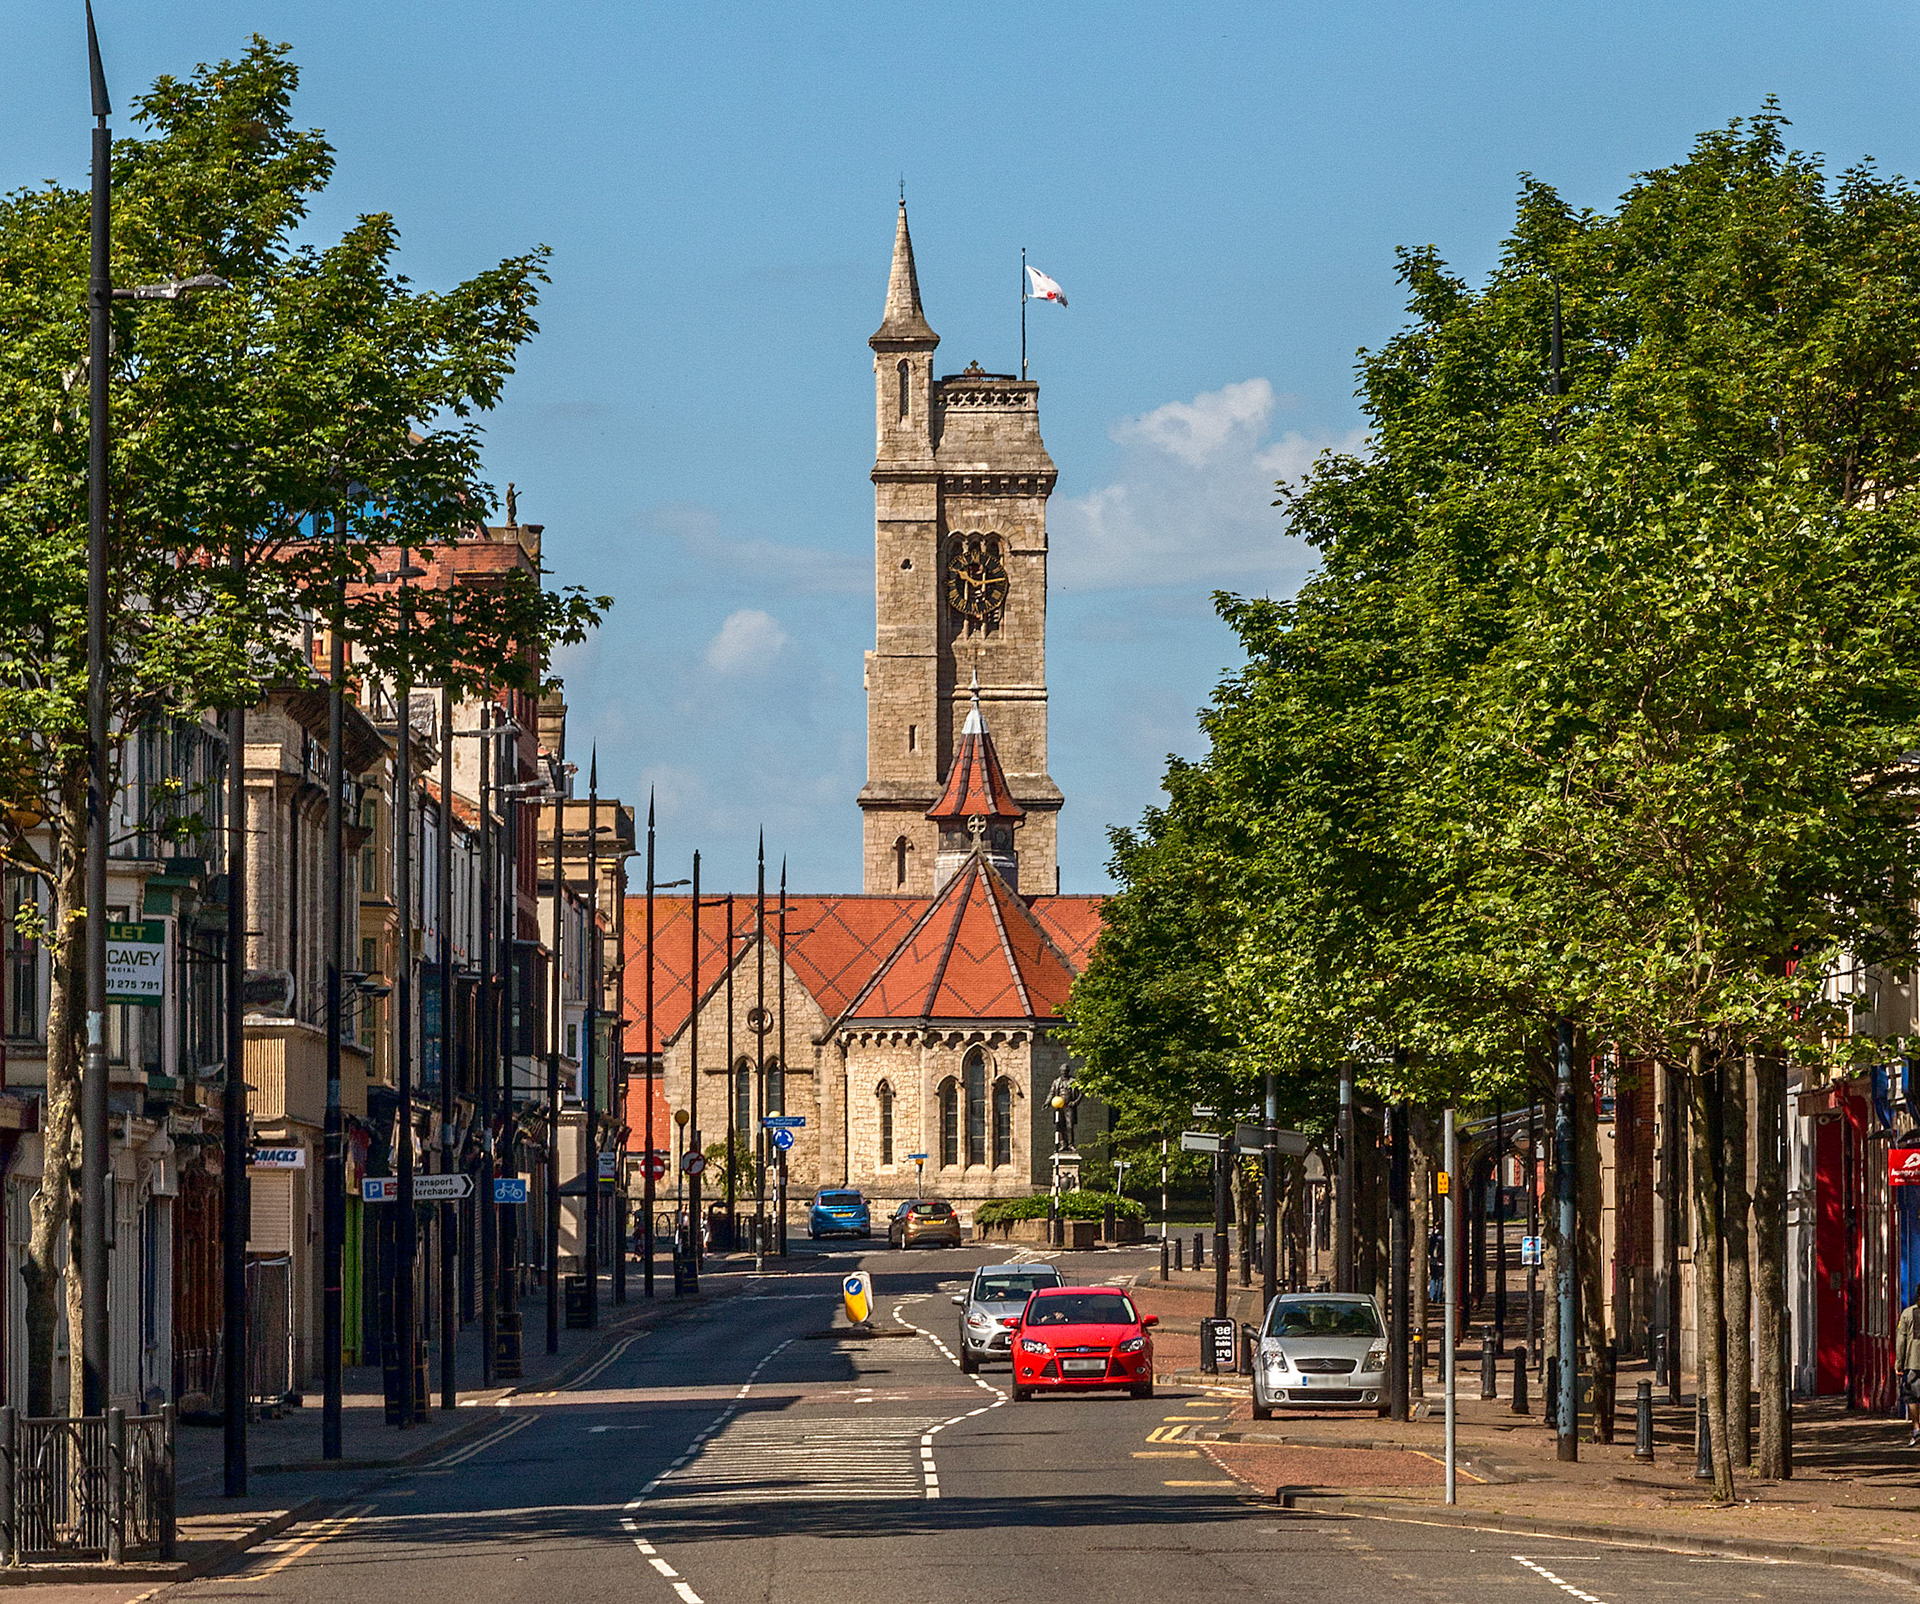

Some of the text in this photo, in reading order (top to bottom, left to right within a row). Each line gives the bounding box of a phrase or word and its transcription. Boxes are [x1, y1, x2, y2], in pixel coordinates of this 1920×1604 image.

[110, 926, 146, 939] LET
[107, 949, 160, 966] CAVEY
[117, 980, 137, 989] 275
[140, 981, 160, 990] 791
[255, 1150, 298, 1162] SNACKS
[414, 1178, 453, 1187] ransport
[369, 1183, 379, 1196] P
